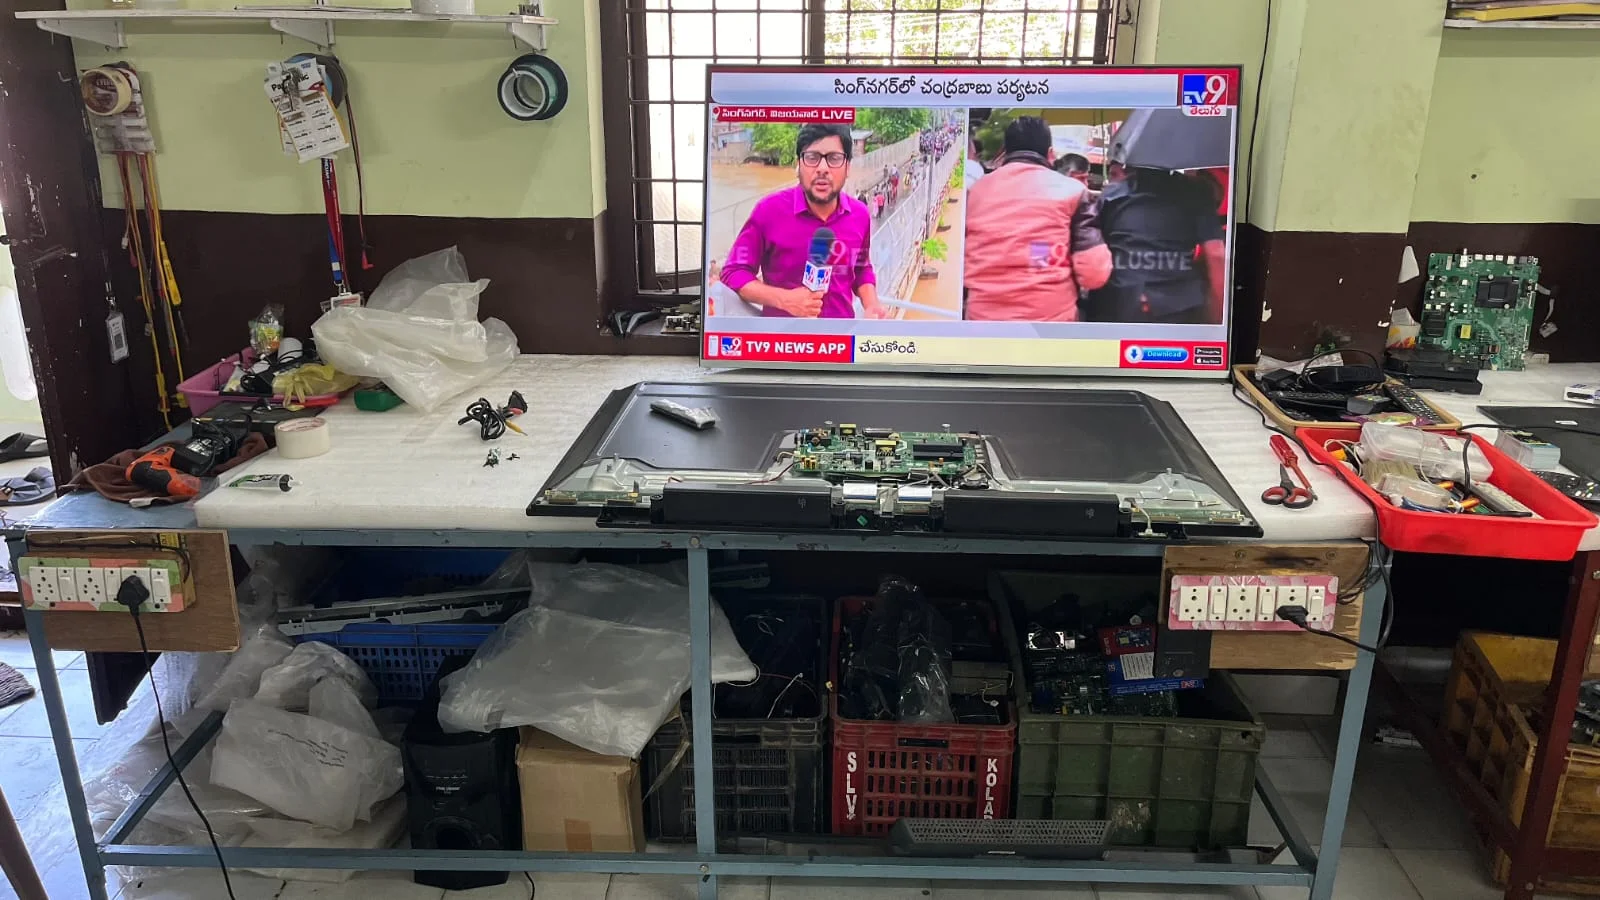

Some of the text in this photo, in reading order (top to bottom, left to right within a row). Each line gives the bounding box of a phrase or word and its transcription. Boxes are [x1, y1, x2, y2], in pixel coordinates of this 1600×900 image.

[920, 79, 993, 98] చంద్రబాబు
[997, 79, 1050, 102] పర్యటన
[1183, 75, 1227, 104] TV9
[821, 110, 854, 120] LIVE
[1190, 105, 1221, 115] తెలుగు
[1114, 251, 1193, 271] LUSIVE
[746, 341, 846, 355] TV9 NEWS APP
[1147, 350, 1182, 358] Download
